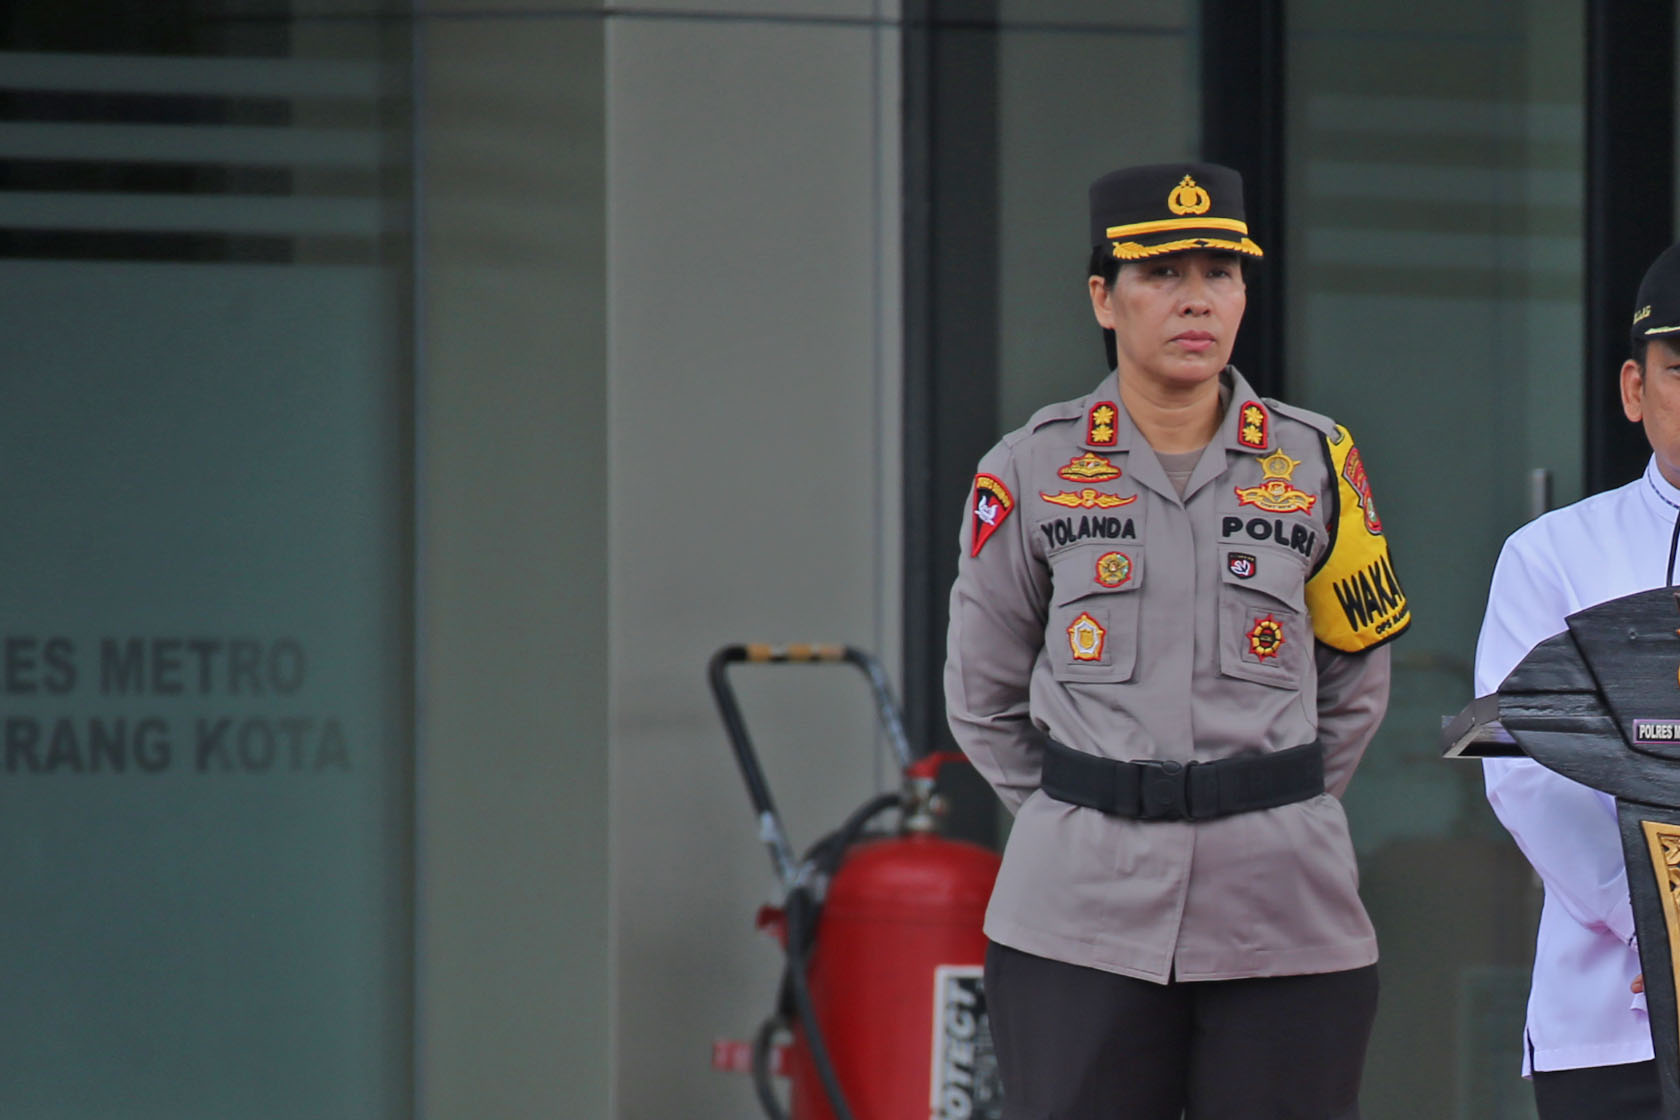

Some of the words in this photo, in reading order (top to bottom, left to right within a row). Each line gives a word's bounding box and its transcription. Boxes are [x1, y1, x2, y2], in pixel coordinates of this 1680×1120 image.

[1041, 516, 1136, 548] YOLANDA
[1222, 516, 1315, 557] POLRI
[98, 636, 308, 696] METRO
[194, 716, 352, 774] KOTA
[1639, 724, 1673, 739] POLRES
